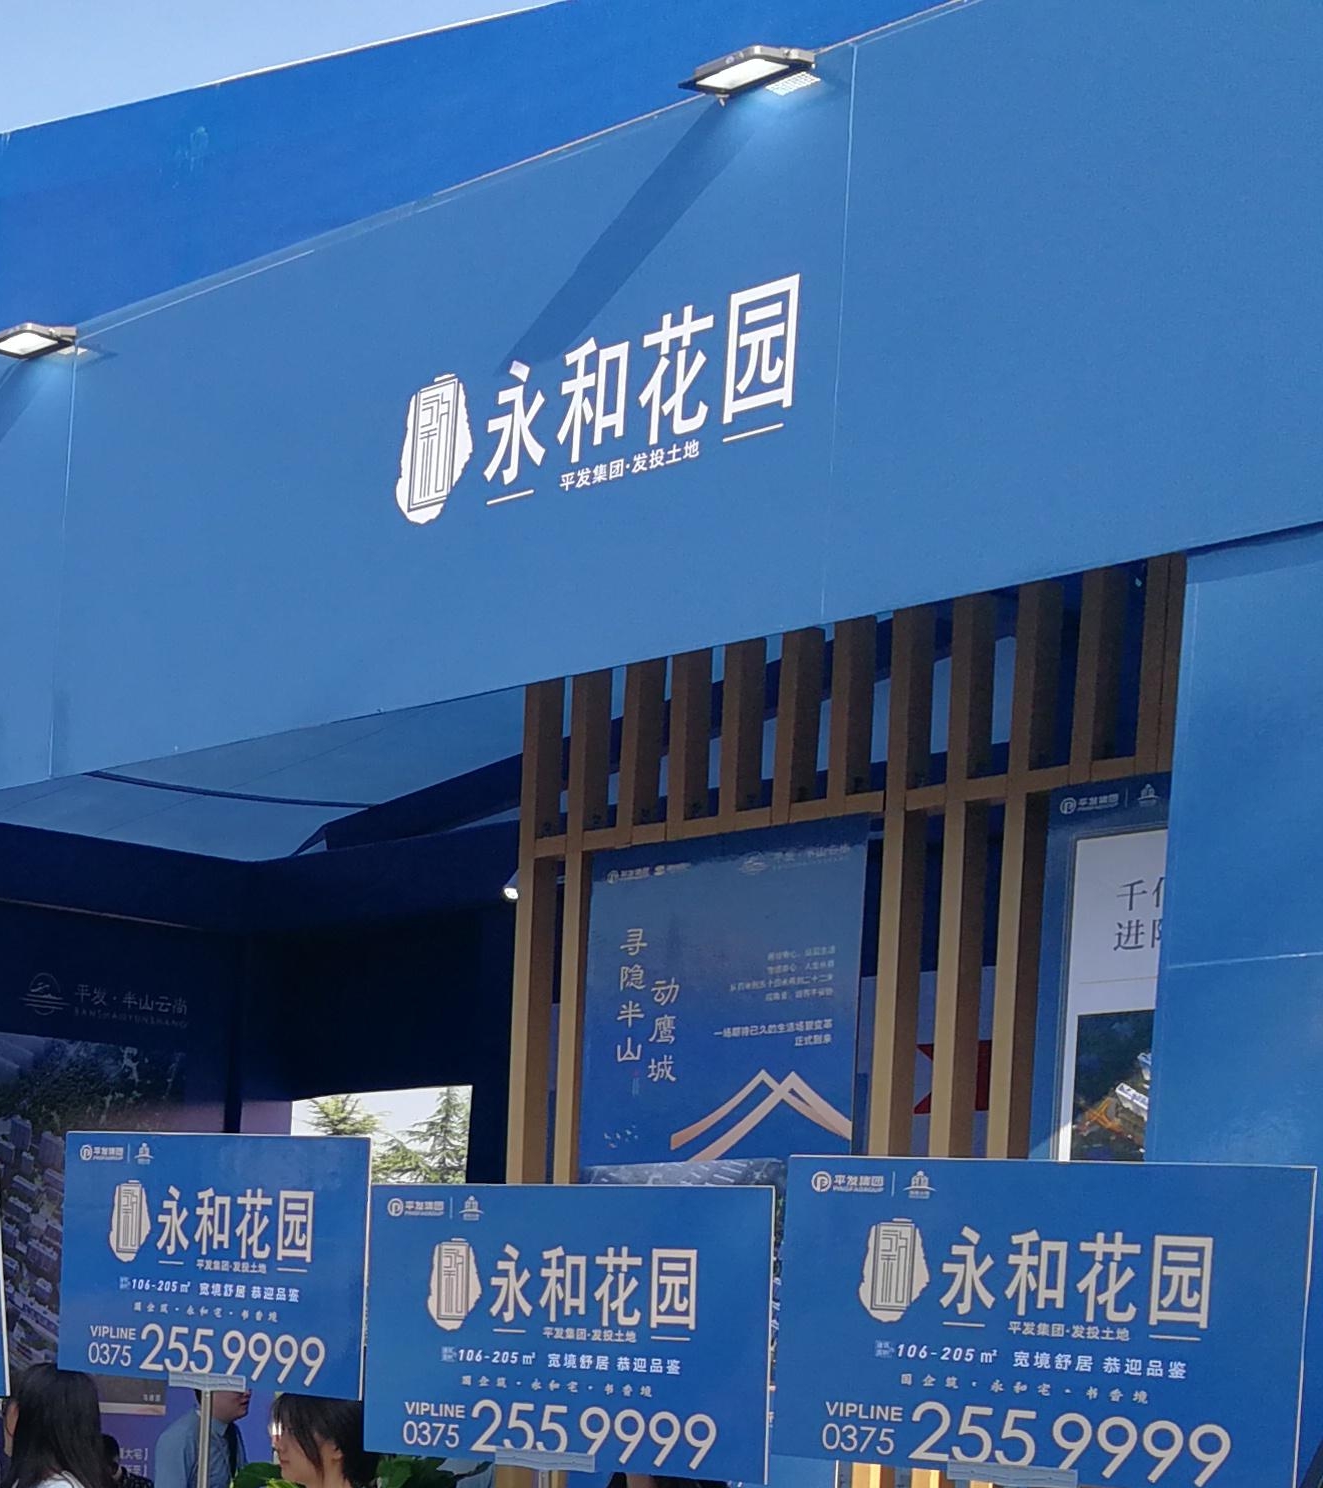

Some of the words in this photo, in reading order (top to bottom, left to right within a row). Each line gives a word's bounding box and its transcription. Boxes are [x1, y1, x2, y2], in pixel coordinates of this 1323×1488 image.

[483, 273, 801, 486] 永和花园
[559, 439, 700, 492] 平发集团·发投土地
[616, 928, 648, 1063] 寻隐半山
[647, 977, 680, 1083] 动鹰城
[156, 1184, 315, 1263] 永和花园
[488, 1243, 698, 1330] 永和花园
[939, 1226, 1214, 1329] 永和花园
[198, 1282, 246, 1299] 宽境舒居
[250, 1286, 300, 1303] 恭迎品鉴
[90, 1325, 136, 1341] VIPLINE
[542, 1326, 637, 1344] 平发集团·发投土地
[1007, 1320, 1131, 1342] 平发集团·发投土地
[88, 1342, 132, 1368] 0375
[547, 1352, 610, 1372] 宽境舒居
[616, 1356, 682, 1376] 恭迎品鉴
[1012, 1350, 1094, 1373] 宽境舒居
[1102, 1355, 1188, 1380] 恭迎品鉴
[405, 1401, 466, 1419] VIPLINE
[826, 1401, 903, 1422] VIPLINE
[402, 1420, 461, 1449] 0375
[821, 1423, 896, 1456] 0375
